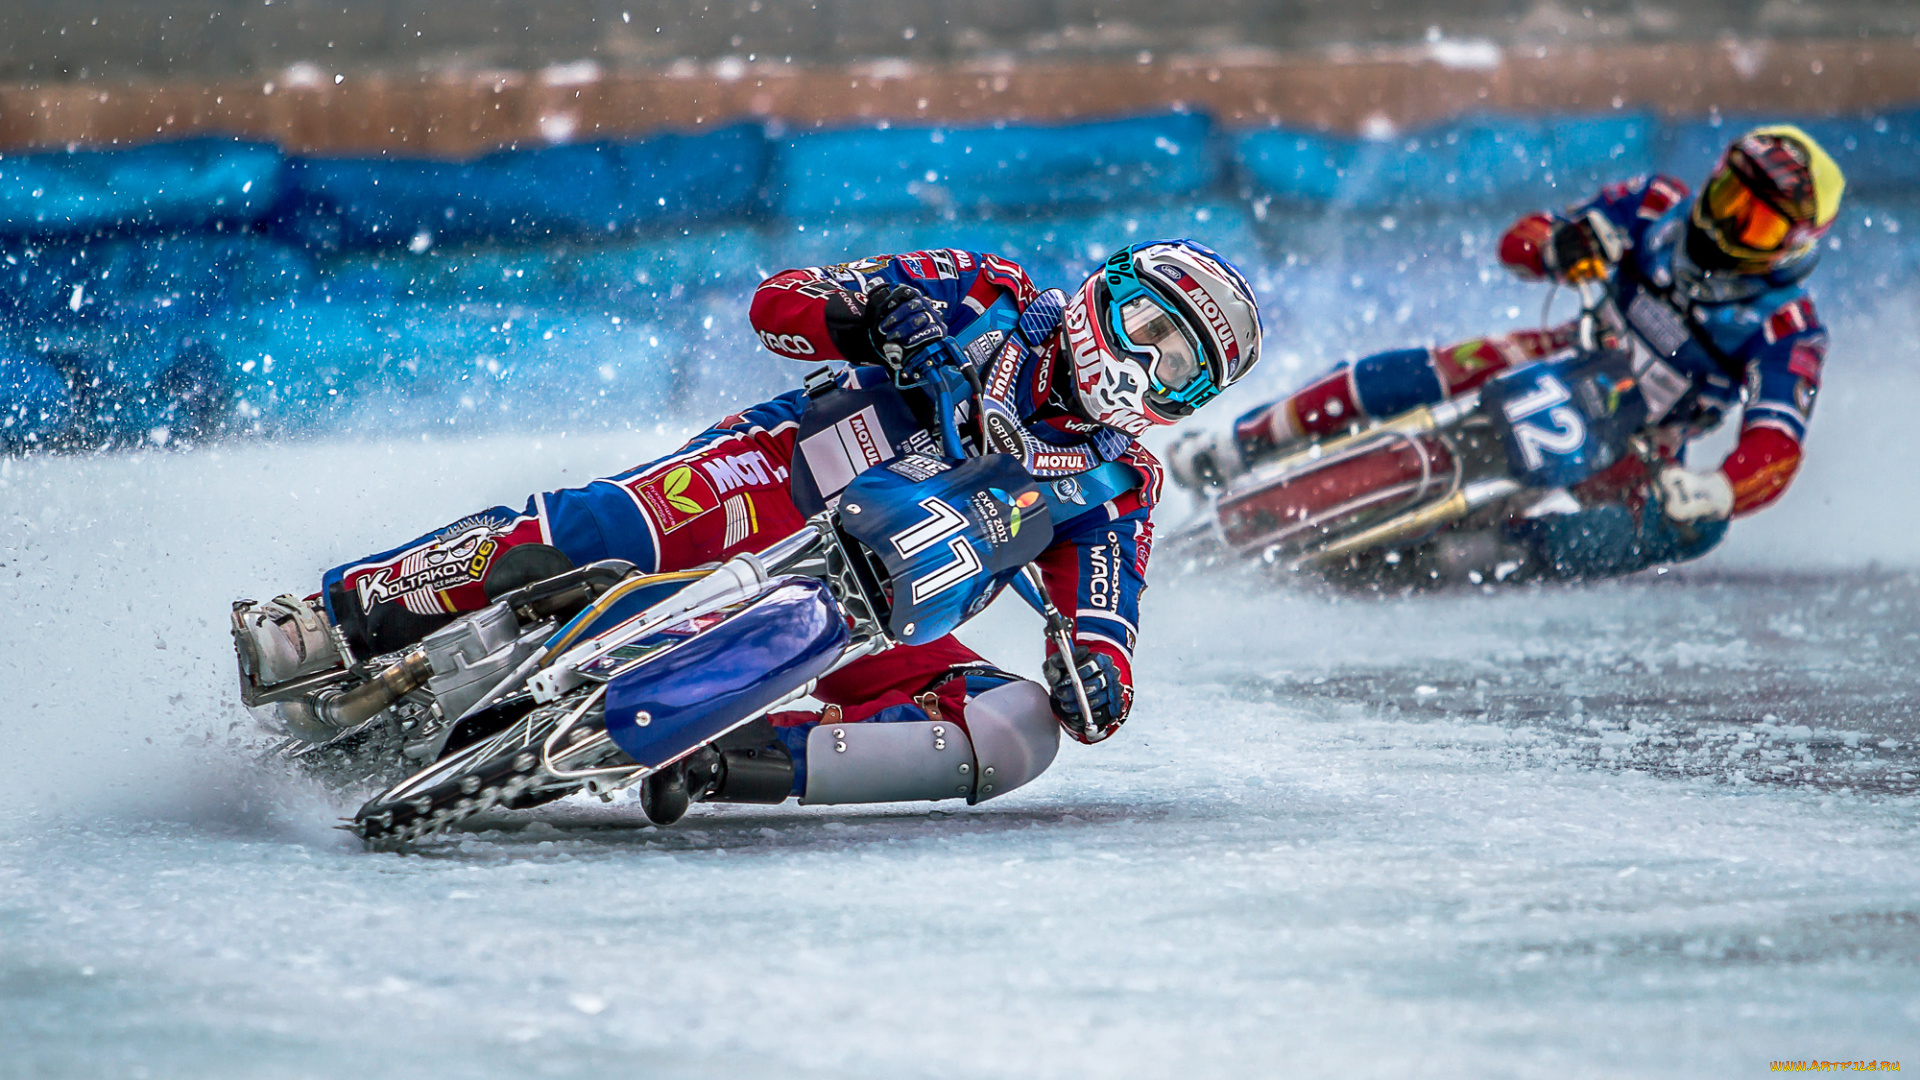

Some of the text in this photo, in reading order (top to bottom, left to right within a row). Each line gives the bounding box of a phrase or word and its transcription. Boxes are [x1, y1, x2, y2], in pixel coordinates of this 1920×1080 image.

[1107, 247, 1135, 286] 0%
[1066, 286, 1103, 384] MOTUL
[1187, 288, 1235, 351] MOTUL
[993, 344, 1019, 398] MOTUL
[850, 418, 881, 467] MOTUL
[988, 417, 1022, 460] ORTEMA
[1104, 407, 1152, 437] MO
[1503, 372, 1587, 472] 12
[701, 450, 790, 495] MOT
[1035, 454, 1084, 469] MOTUL
[977, 491, 1009, 543] EXPO 2017
[469, 541, 493, 577] 106
[889, 495, 983, 606] 11
[358, 560, 471, 610] KOLTAKOV
[1089, 545, 1109, 608] WACO
